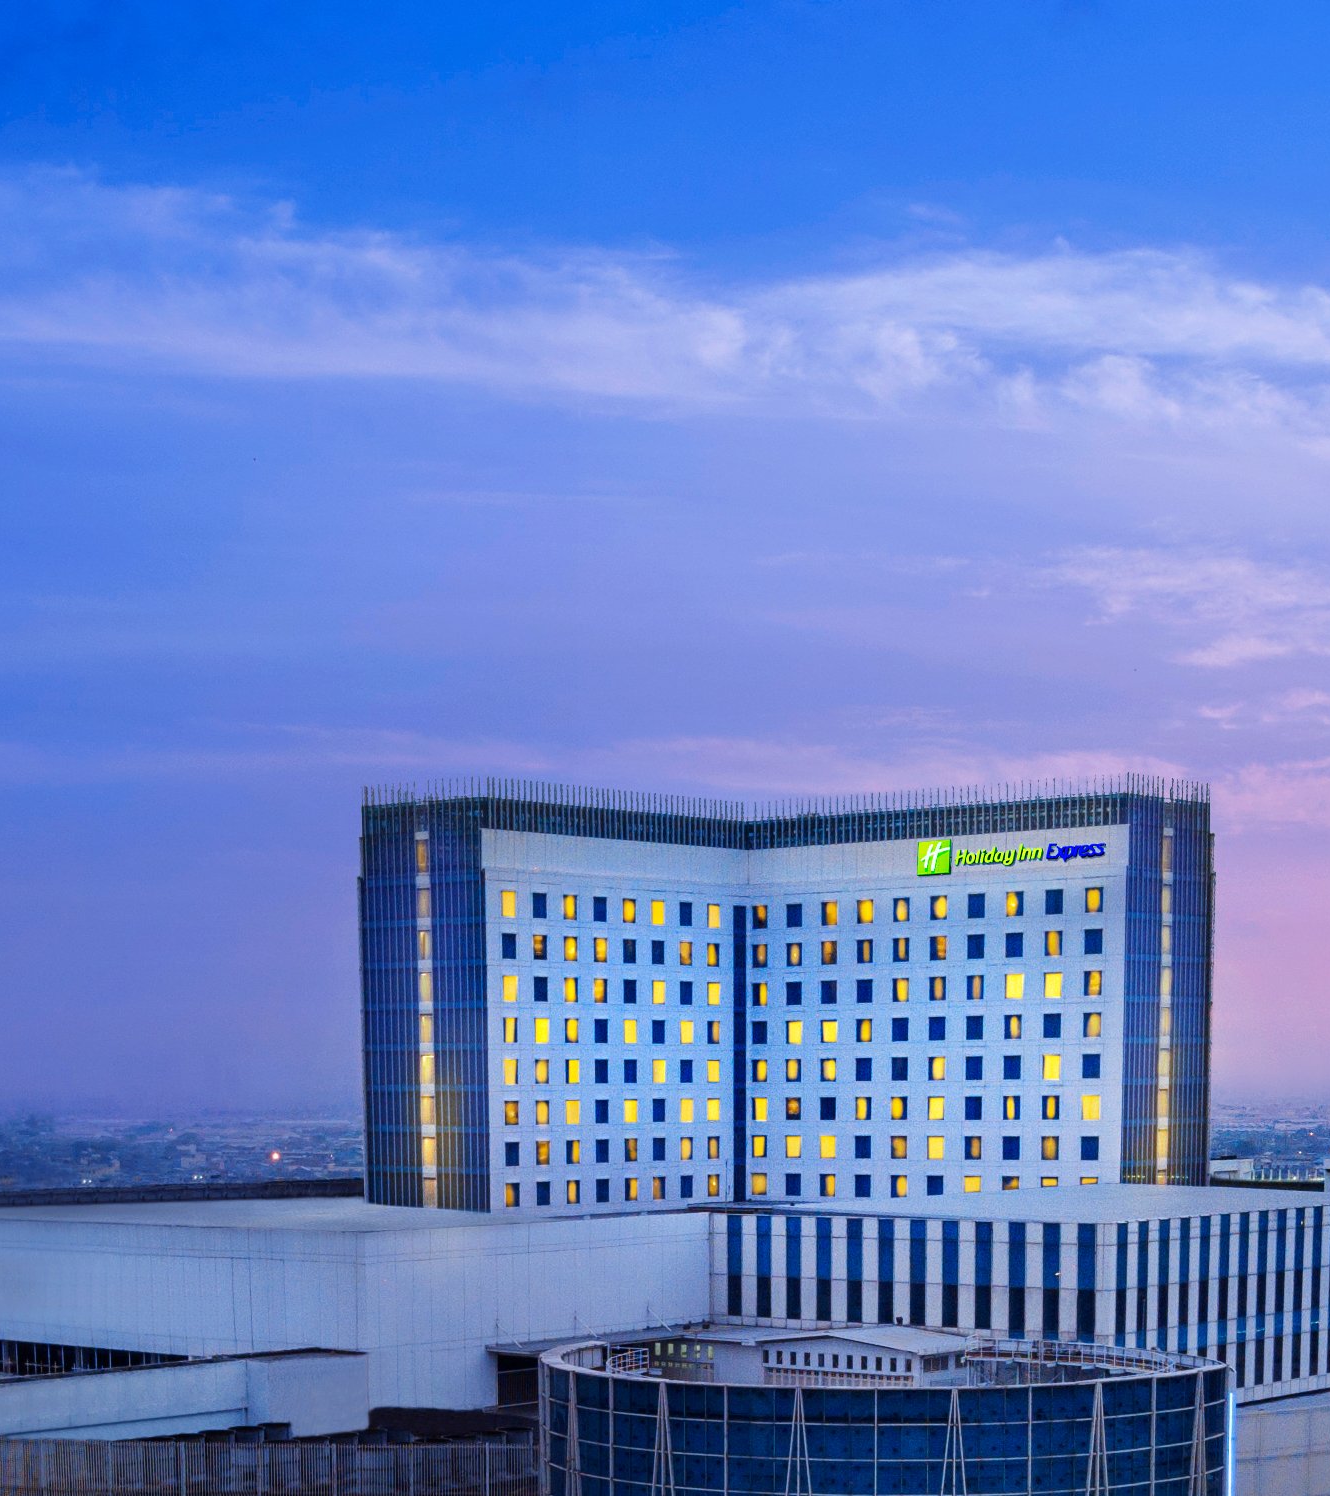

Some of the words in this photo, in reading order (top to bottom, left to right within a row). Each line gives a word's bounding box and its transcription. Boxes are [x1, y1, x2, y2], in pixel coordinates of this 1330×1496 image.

[955, 847, 1016, 866] Holiday
[1016, 842, 1043, 861] Inn
[1046, 843, 1106, 862] Express
